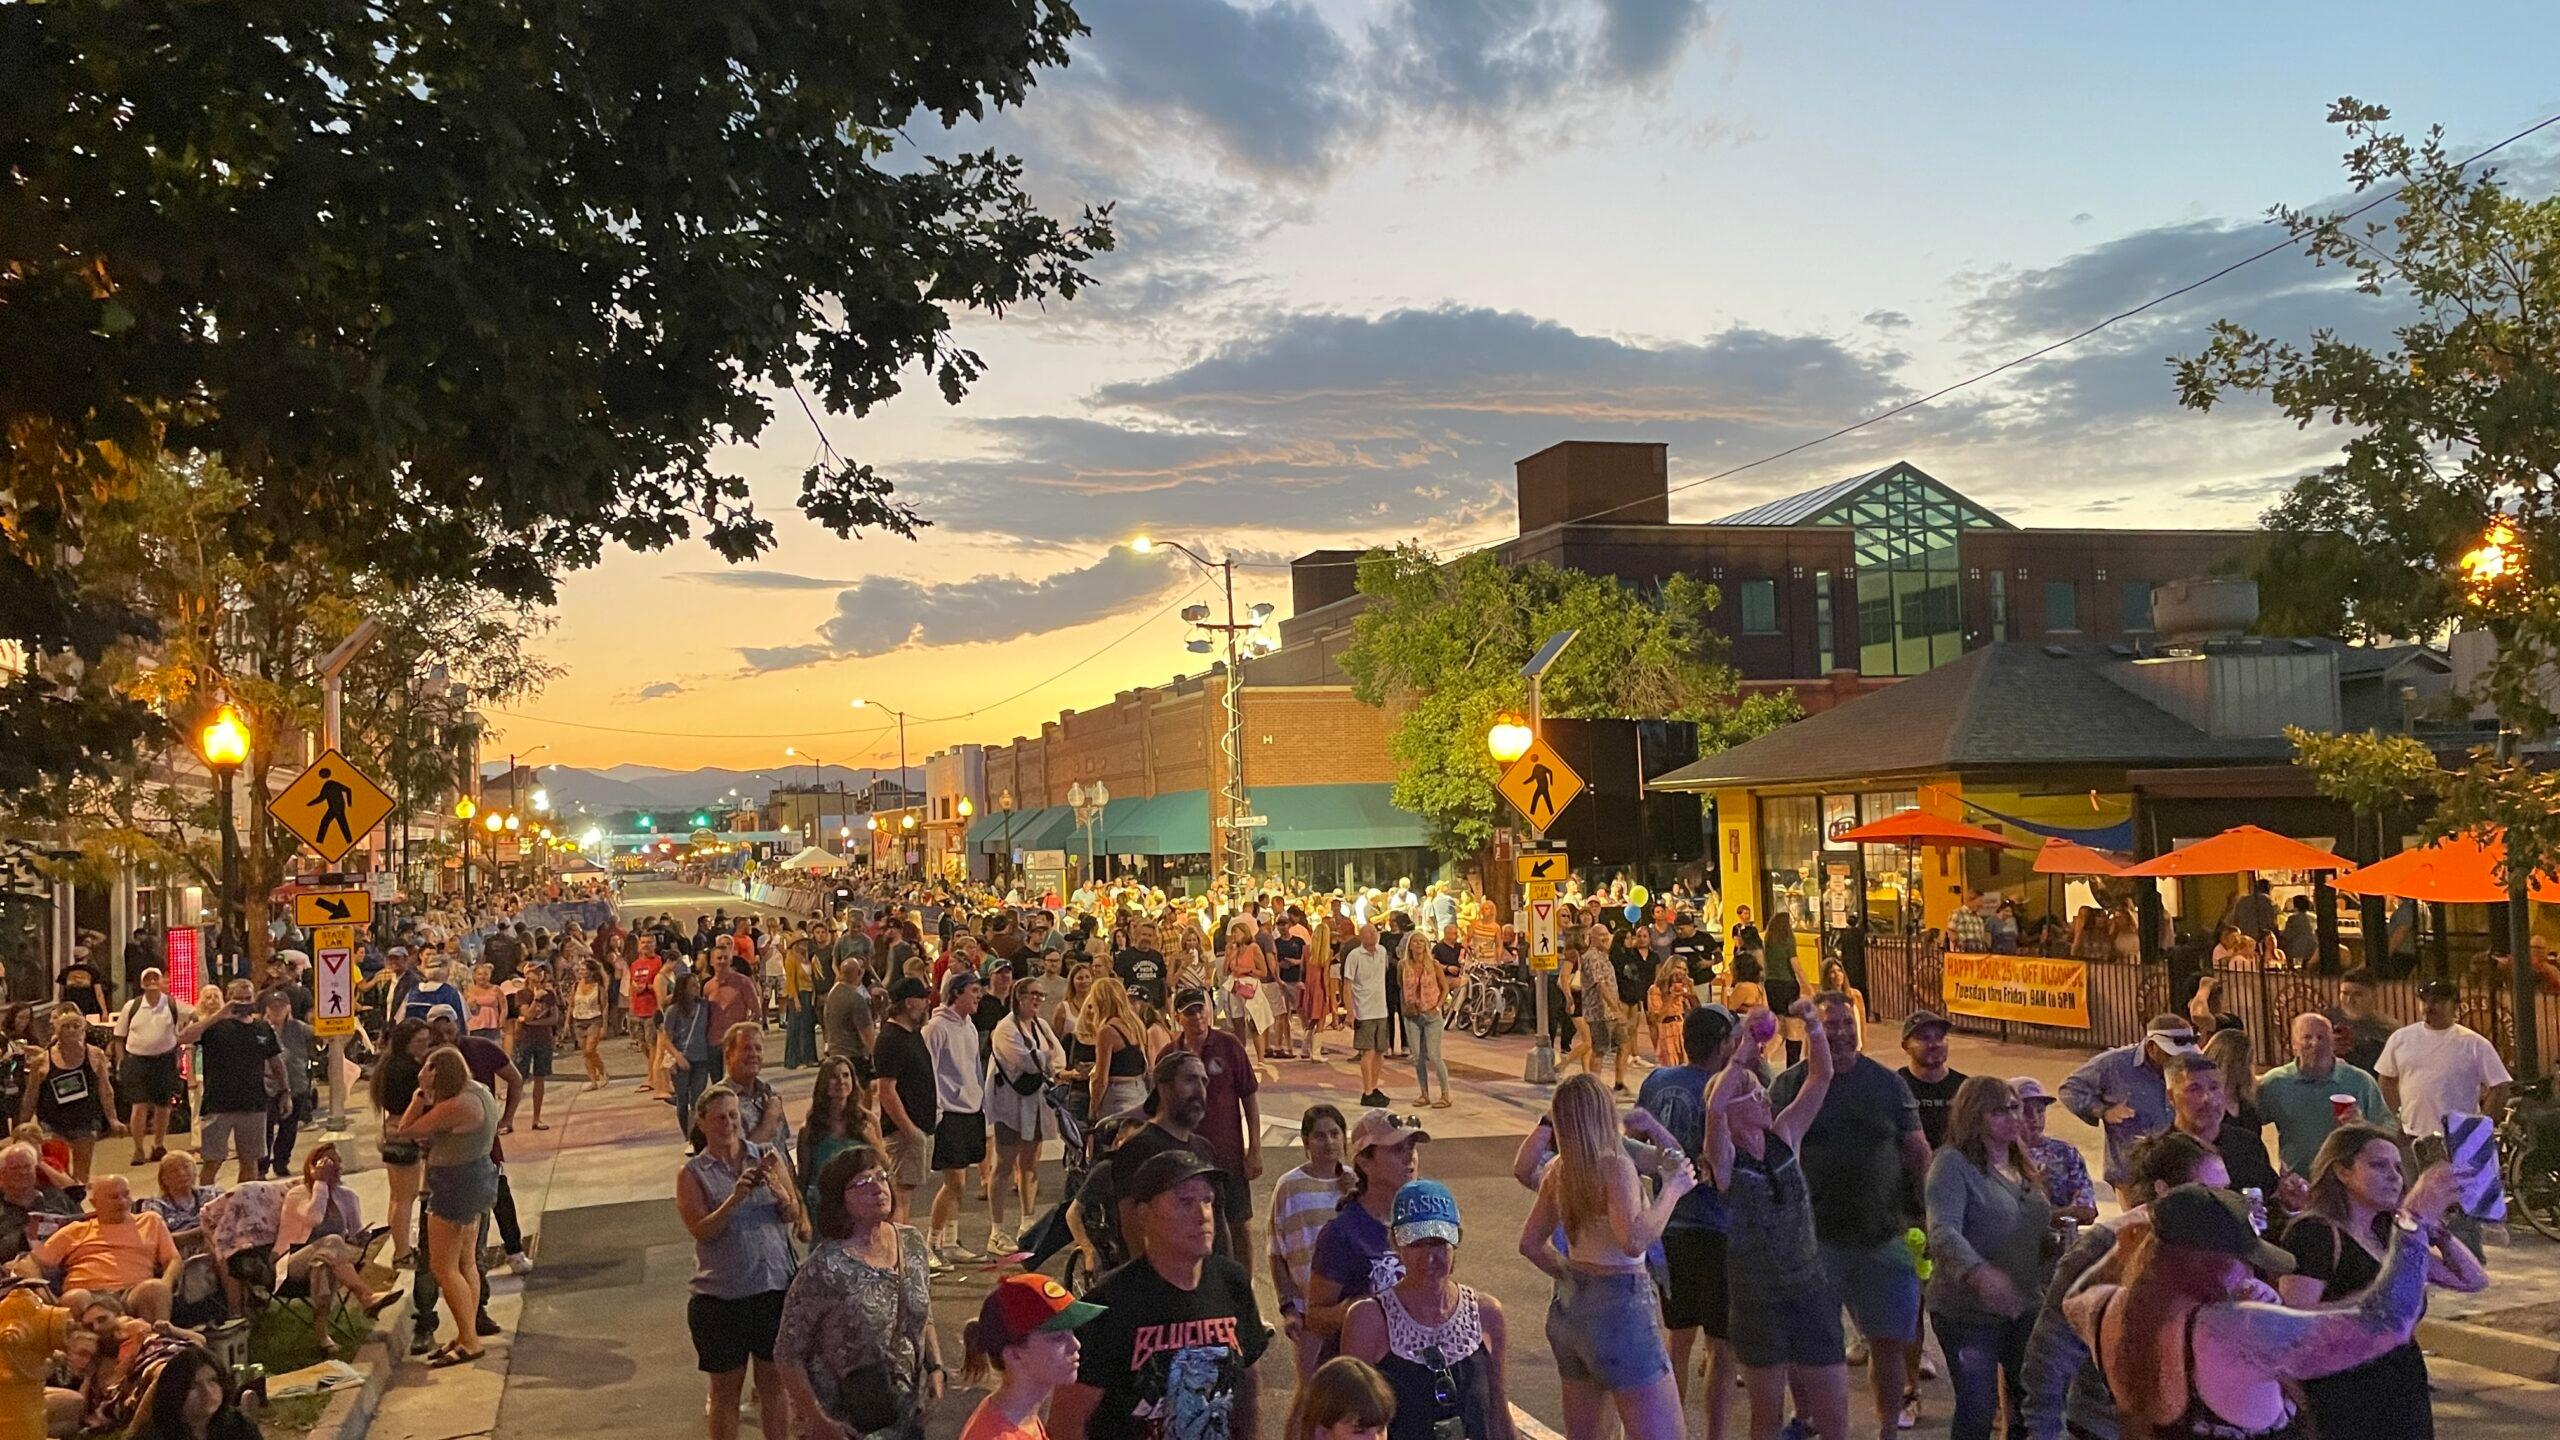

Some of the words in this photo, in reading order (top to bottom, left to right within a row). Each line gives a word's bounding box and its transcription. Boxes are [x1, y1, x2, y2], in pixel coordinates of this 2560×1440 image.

[321, 931, 345, 939] STATE
[1947, 958, 1974, 978] HAPPY
[1976, 959, 2000, 981] HOUR
[2021, 964, 2038, 984] OFF
[1954, 983, 1986, 1002] Tuesday
[1987, 986, 2002, 1002] thru
[2003, 987, 2028, 1006] Friday
[2030, 989, 2047, 1007] 9AM
[2048, 993, 2057, 1008] to
[2058, 992, 2076, 1009] 5PM
[1397, 1195, 1450, 1220] SASSY
[1130, 1316, 1244, 1371] BLUCIFER
